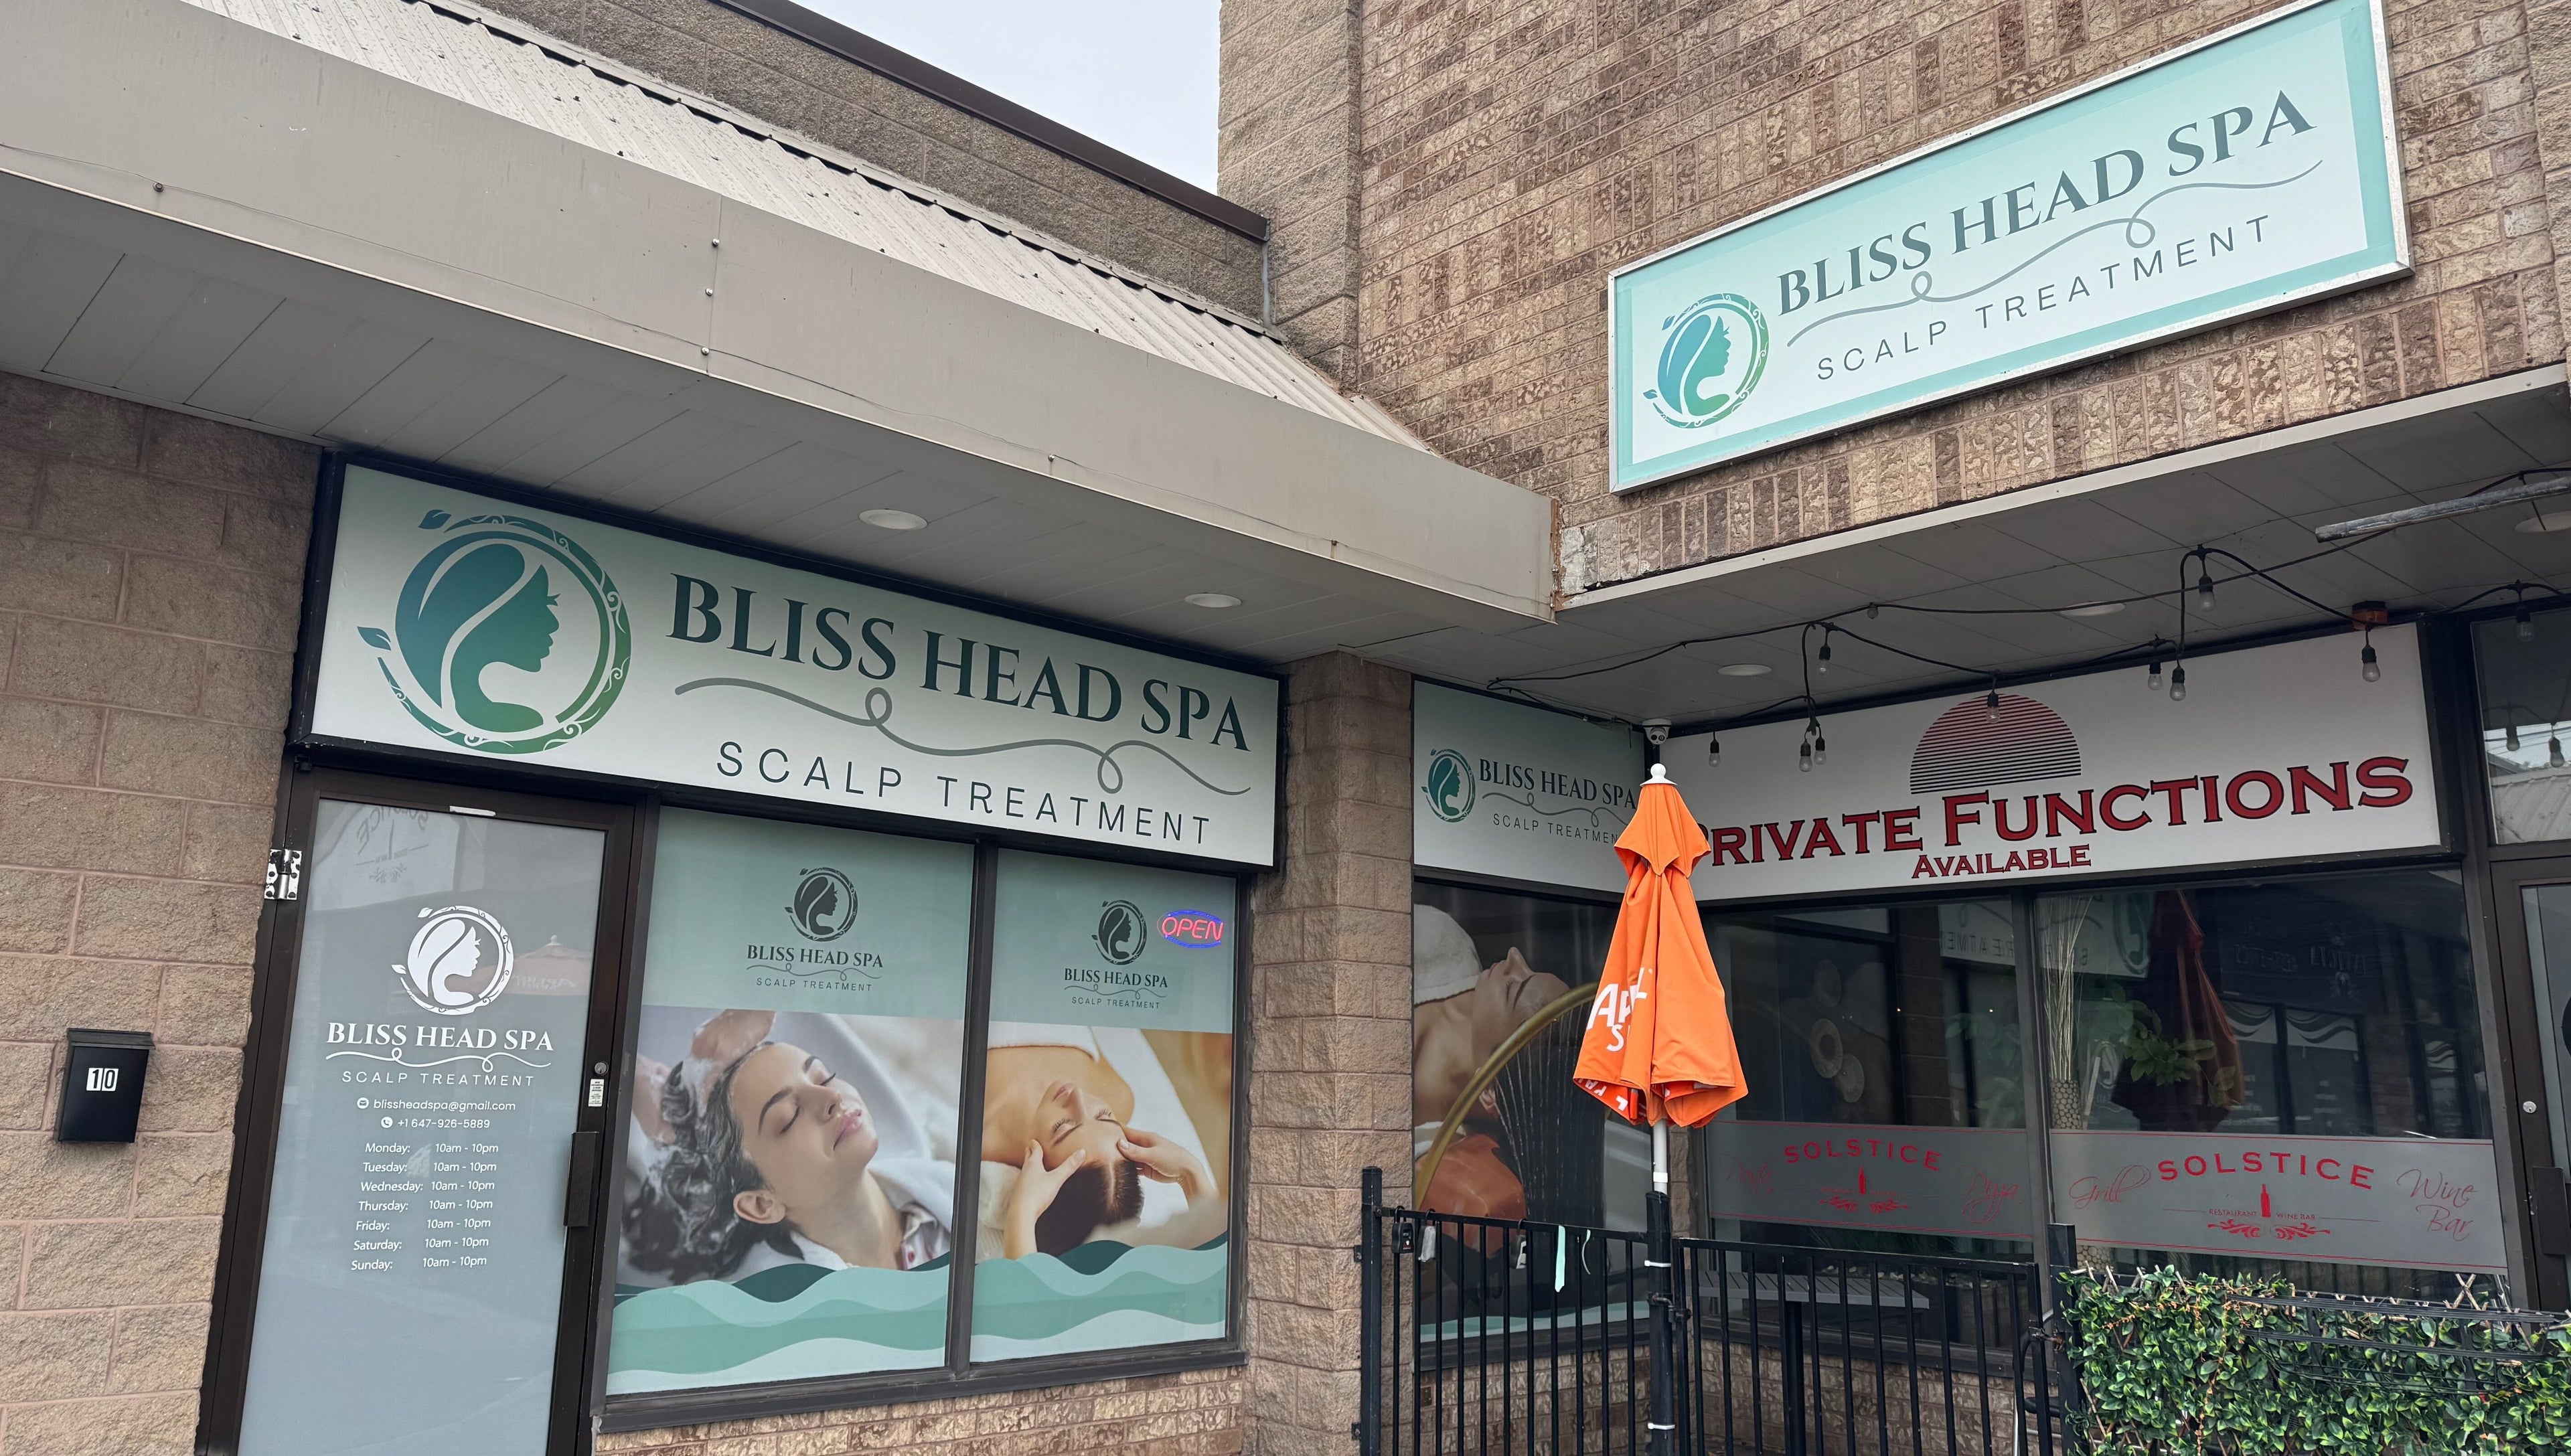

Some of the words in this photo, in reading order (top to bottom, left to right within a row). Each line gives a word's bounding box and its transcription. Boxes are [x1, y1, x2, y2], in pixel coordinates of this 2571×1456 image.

[1778, 222, 1932, 316] BLISS
[1951, 149, 2143, 255] HEAD
[2167, 90, 2317, 177] SPA
[1818, 321, 1947, 382] SCALP
[1976, 216, 2271, 330] TREATMENT
[666, 573, 896, 680] BLISS
[919, 629, 1122, 722] HEAD
[1140, 679, 1251, 752] SPA
[716, 742, 902, 798] SCALP
[937, 776, 1209, 845] TREATMENT
[1479, 758, 1535, 790] BLISS
[1541, 771, 1597, 801] HEAD
[1602, 783, 1636, 809] SPA
[1697, 805, 1923, 866] RIVATE
[1942, 756, 2413, 846] FUNCTIONS
[1493, 813, 1539, 831] SCALP
[1547, 822, 1618, 845] TREATMEN
[1912, 843, 2092, 879] AVAILABLE
[1162, 916, 1223, 941] OPEN
[747, 945, 795, 962] BLISS
[799, 949, 849, 965] HEAD
[853, 952, 883, 968] SPA
[756, 978, 796, 987] SCALP
[803, 980, 872, 991] TREATMENT
[1065, 968, 1100, 983] BLISS
[1104, 971, 1141, 986] HEAD
[1144, 974, 1168, 988] SPA
[1071, 997, 1102, 1005] SCALP
[1107, 999, 1160, 1009] TREATMENT
[326, 1022, 407, 1046] BLISS
[415, 1026, 497, 1049] HEAD
[503, 1030, 554, 1051] SPA
[91, 1068, 116, 1089] 10
[342, 1071, 408, 1084] SCALP
[420, 1073, 534, 1086] TREATMENT
[373, 1099, 516, 1112] blissheadspa@gmail.com
[411, 1119, 490, 1129] 647-926-5889
[365, 1143, 410, 1155] Monday:
[435, 1143, 461, 1153] 10am
[472, 1143, 499, 1155] 10pm
[1784, 1139, 1942, 1171] SOLSTICE
[363, 1162, 407, 1174] Tuesday:
[433, 1162, 459, 1171] 10am
[470, 1162, 497, 1173] 10pm
[2158, 1152, 2375, 1190] SOLSTICE
[360, 1181, 423, 1193] Wednesday:
[431, 1182, 457, 1191] 10am
[468, 1181, 495, 1192] 10pm
[2069, 1165, 2151, 1210] Grill
[2397, 1169, 2478, 1208] Wine
[358, 1200, 408, 1212] Thursday:
[429, 1200, 455, 1210] 10am
[466, 1200, 493, 1210] 10pm
[2209, 1209, 2257, 1217] RESTAURANT
[356, 1220, 390, 1232] Friday:
[426, 1219, 453, 1228] 10am
[464, 1218, 491, 1230] 10pm
[2416, 1204, 2474, 1242] Bar
[354, 1239, 402, 1251] Saturday:
[424, 1238, 451, 1248] 10am
[462, 1238, 489, 1248] 10pm
[351, 1259, 393, 1271] Sunday:
[422, 1258, 449, 1267] 10am
[459, 1257, 487, 1267] 10pm
